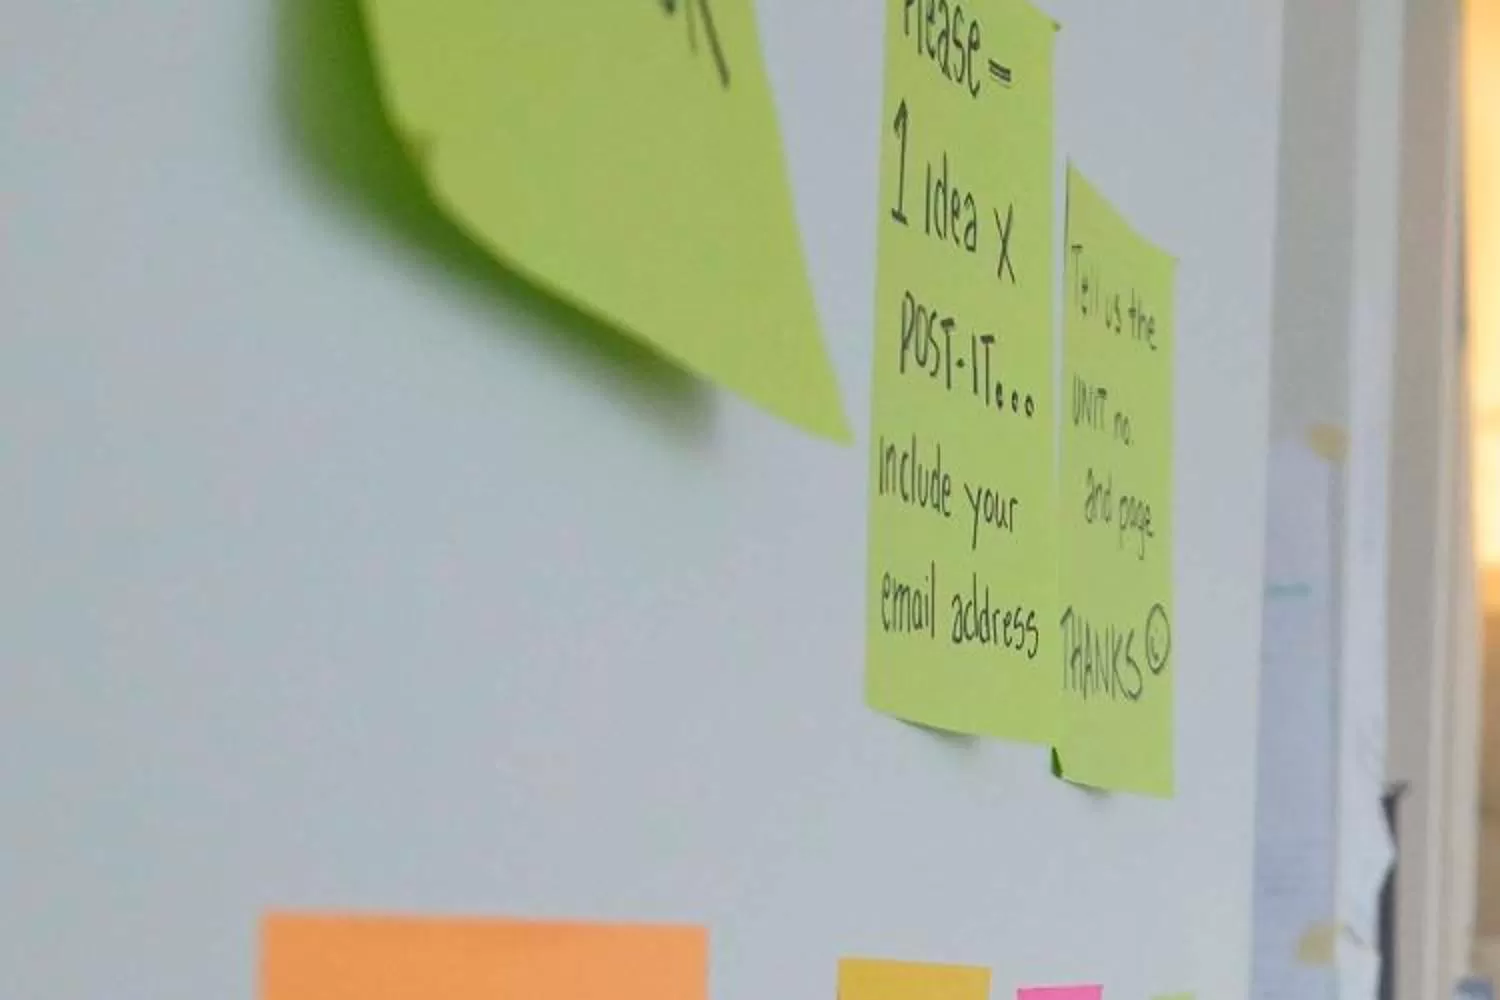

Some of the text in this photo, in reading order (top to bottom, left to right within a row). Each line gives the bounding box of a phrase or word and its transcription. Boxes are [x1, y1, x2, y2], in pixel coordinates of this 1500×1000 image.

[891, 98, 909, 226] 1
[1126, 287, 1157, 351] the
[964, 482, 1018, 551] your
[881, 559, 1039, 659] email address
[1060, 604, 1143, 703] THANKS
